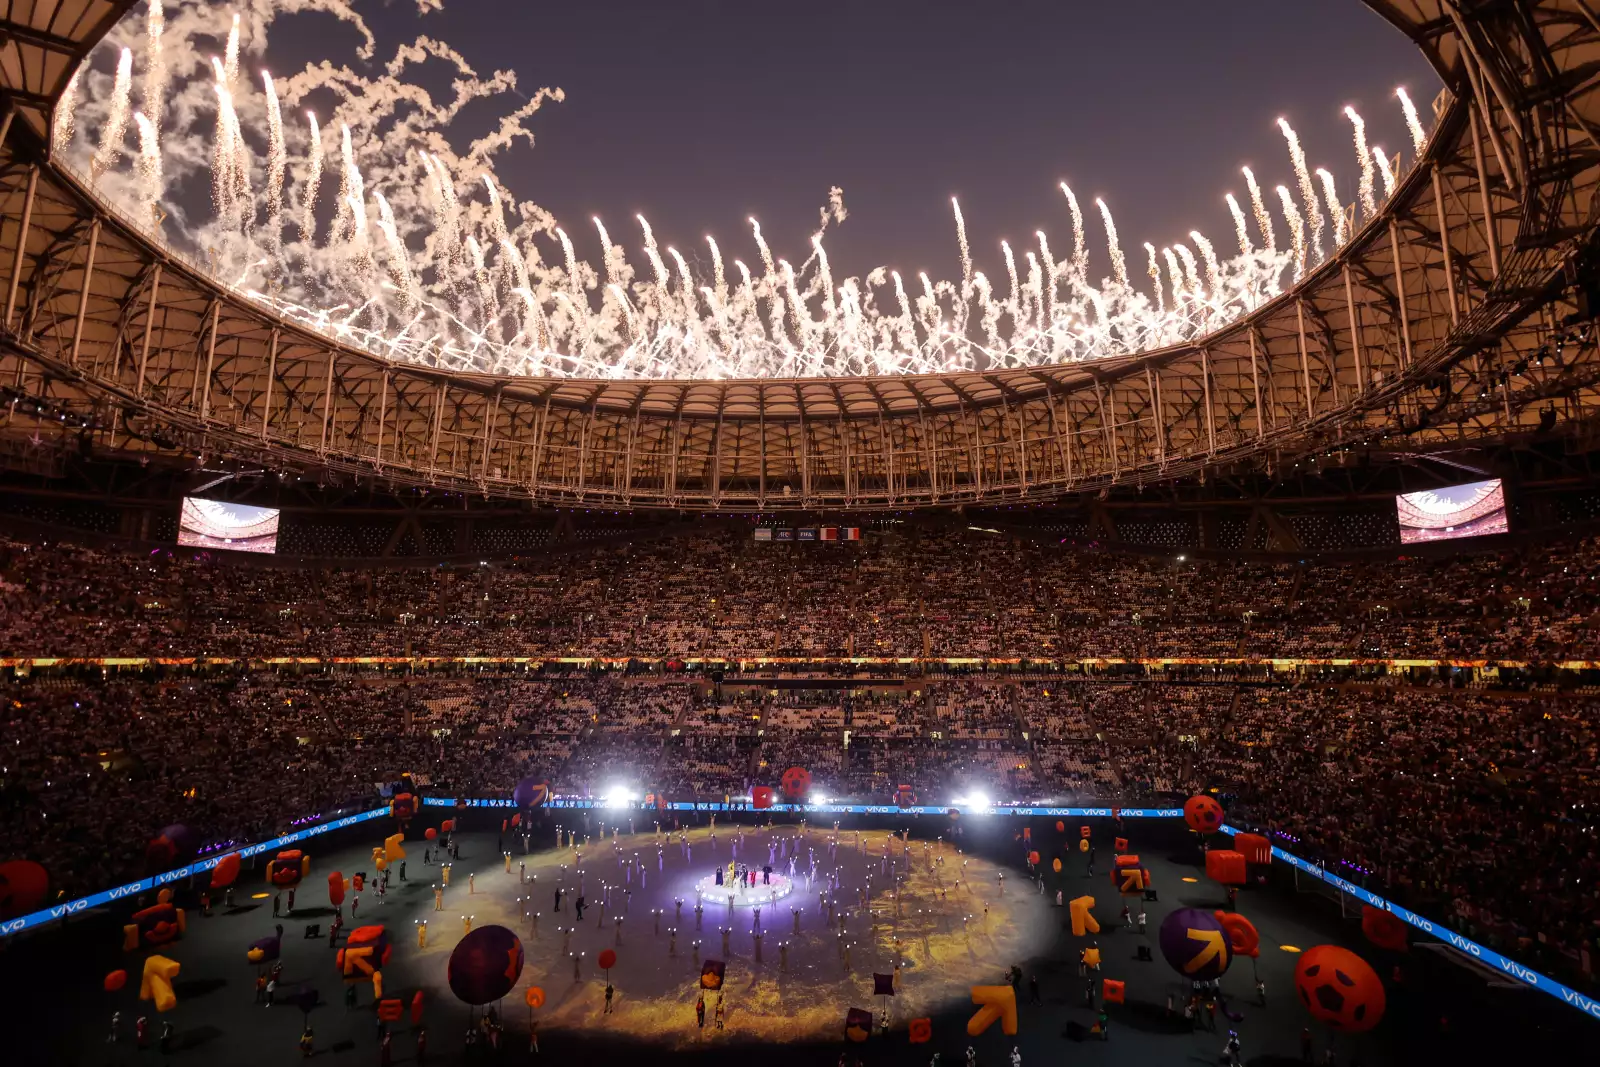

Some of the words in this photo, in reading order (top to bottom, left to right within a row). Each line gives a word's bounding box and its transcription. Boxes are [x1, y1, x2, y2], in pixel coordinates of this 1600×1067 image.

[0, 919, 25, 933] vo
[51, 900, 87, 917] vivo
[109, 883, 141, 899] vivo
[159, 868, 188, 883] vivo
[205, 856, 223, 869] viv
[244, 844, 266, 857] vivo
[278, 833, 299, 845] vivo
[309, 824, 328, 836] vivo
[338, 816, 357, 827] vivo
[367, 808, 385, 818] vivo
[1082, 808, 1106, 816] vivo
[1120, 809, 1143, 817] vivo
[1282, 852, 1298, 865] vivo
[1405, 911, 1433, 932] vivo
[1449, 932, 1480, 956] vivo
[1501, 957, 1538, 984] vivo
